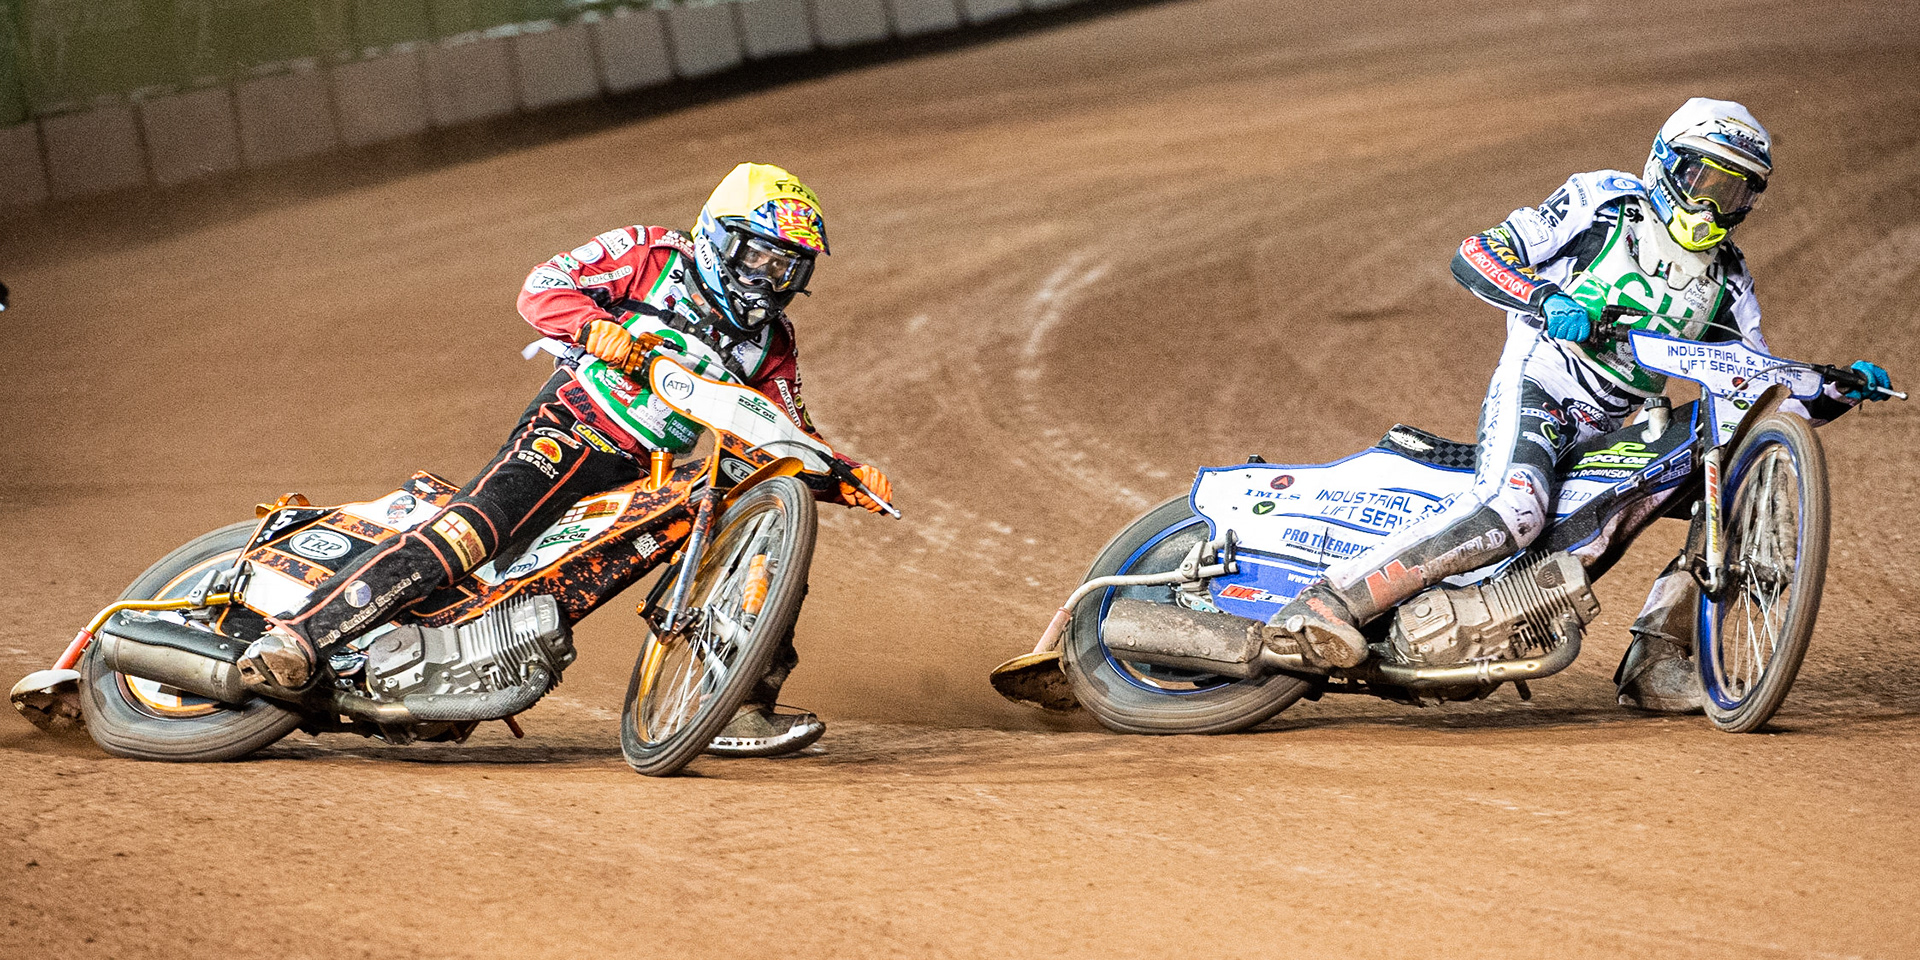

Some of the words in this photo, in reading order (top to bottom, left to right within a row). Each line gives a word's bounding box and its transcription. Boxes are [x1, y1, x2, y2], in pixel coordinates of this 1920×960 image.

[1471, 251, 1528, 296] PROTECTION
[1667, 345, 1738, 364] INDUSTRIAL
[1679, 359, 1708, 371] LIFT
[1710, 359, 1770, 382] SERVICES
[666, 379, 691, 396] ATPI
[738, 397, 762, 413] ROCK
[1578, 454, 1626, 465] ROCK
[1579, 469, 1634, 478] ROBINSON
[1243, 487, 1302, 501] IMLS
[1315, 488, 1413, 514] INDUSTRIAL
[1320, 506, 1356, 521] LIFT
[298, 534, 343, 556] FRP
[1281, 527, 1310, 544] PRO
[1310, 533, 1372, 557] THERAPY
[506, 559, 534, 575] ATPI
[340, 602, 378, 633] Electrical
